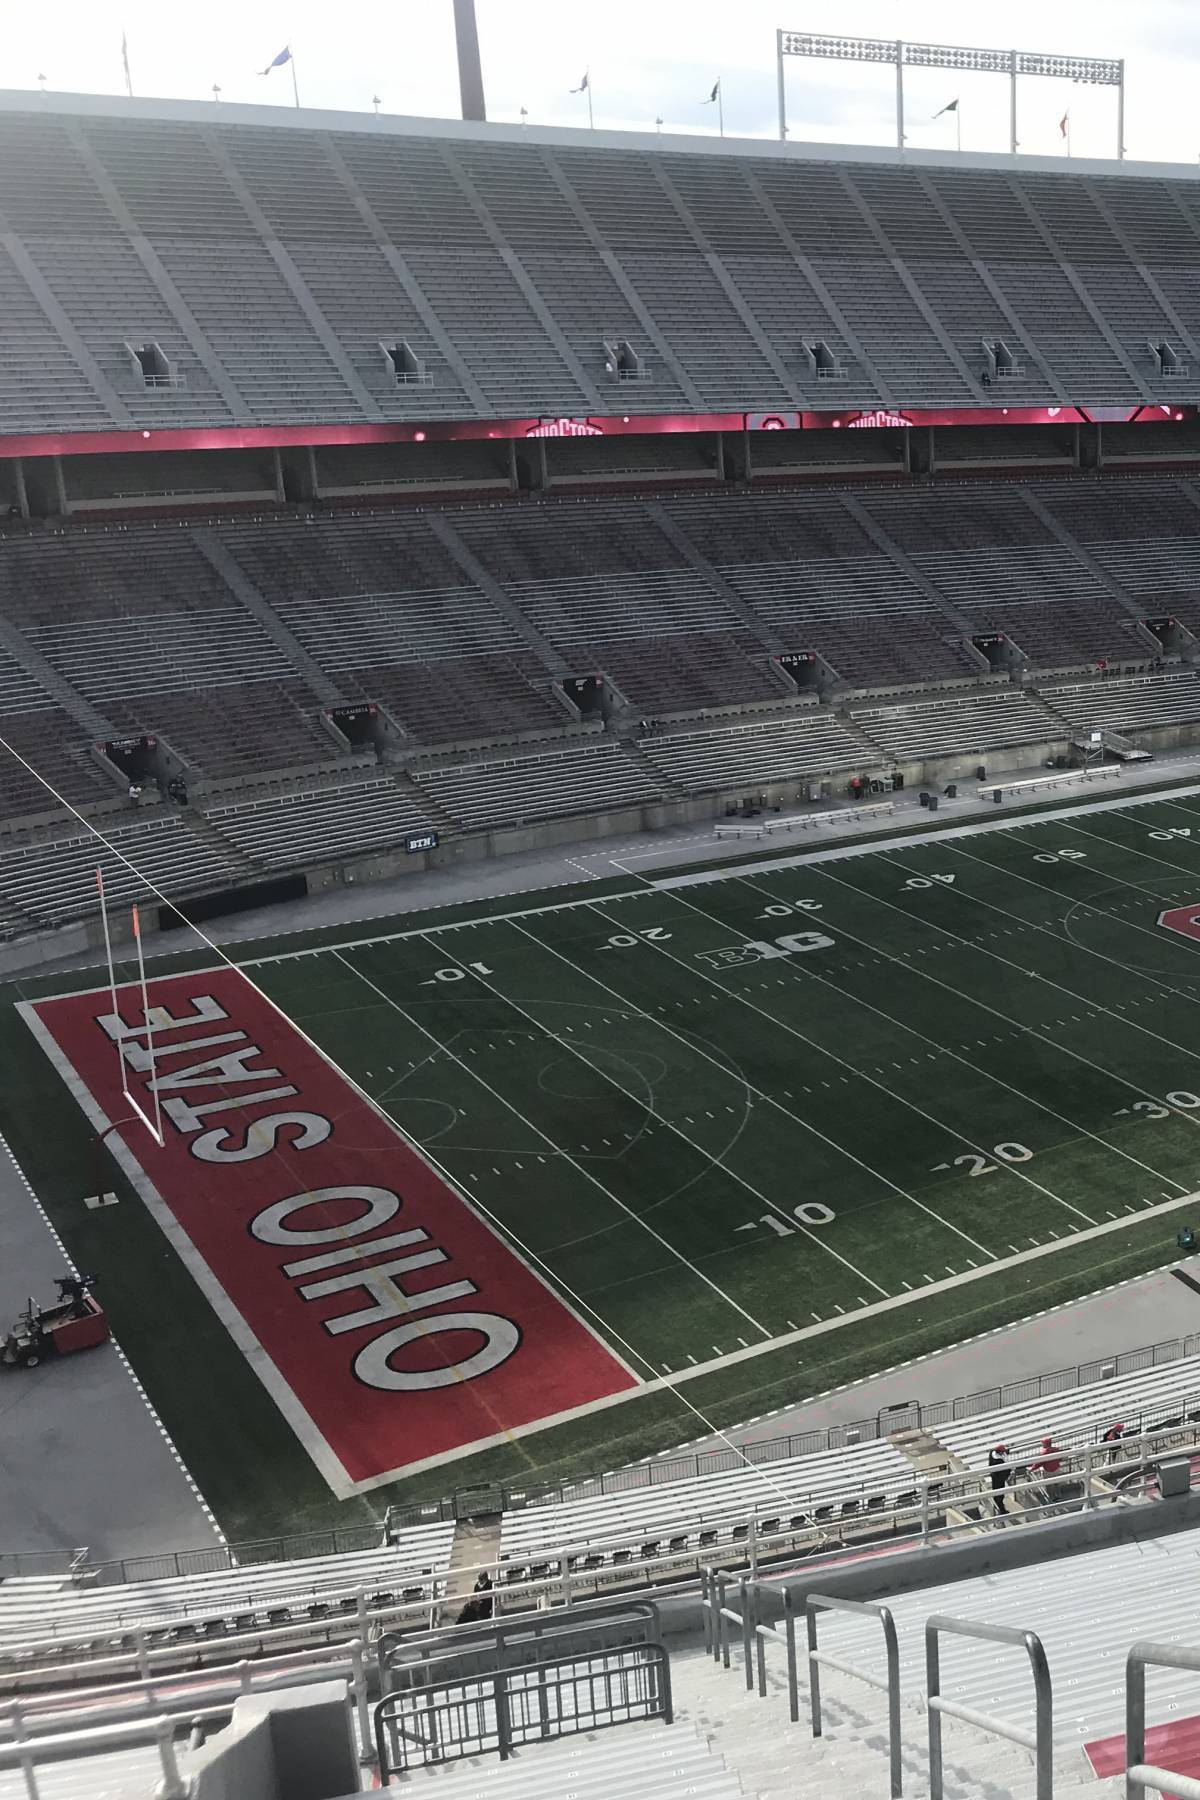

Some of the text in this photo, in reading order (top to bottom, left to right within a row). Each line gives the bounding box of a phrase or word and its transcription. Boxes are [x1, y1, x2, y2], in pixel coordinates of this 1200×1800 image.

[1148, 827, 1194, 842] 40
[1032, 849, 1088, 864] 50
[905, 872, 956, 889] 40
[763, 899, 823, 917] 30
[608, 926, 673, 947] 20
[434, 961, 495, 982] 10
[95, 995, 334, 1164] STATE
[954, 1141, 1034, 1178] 20
[756, 1201, 836, 1237] 10
[249, 1184, 522, 1391] OHIO
